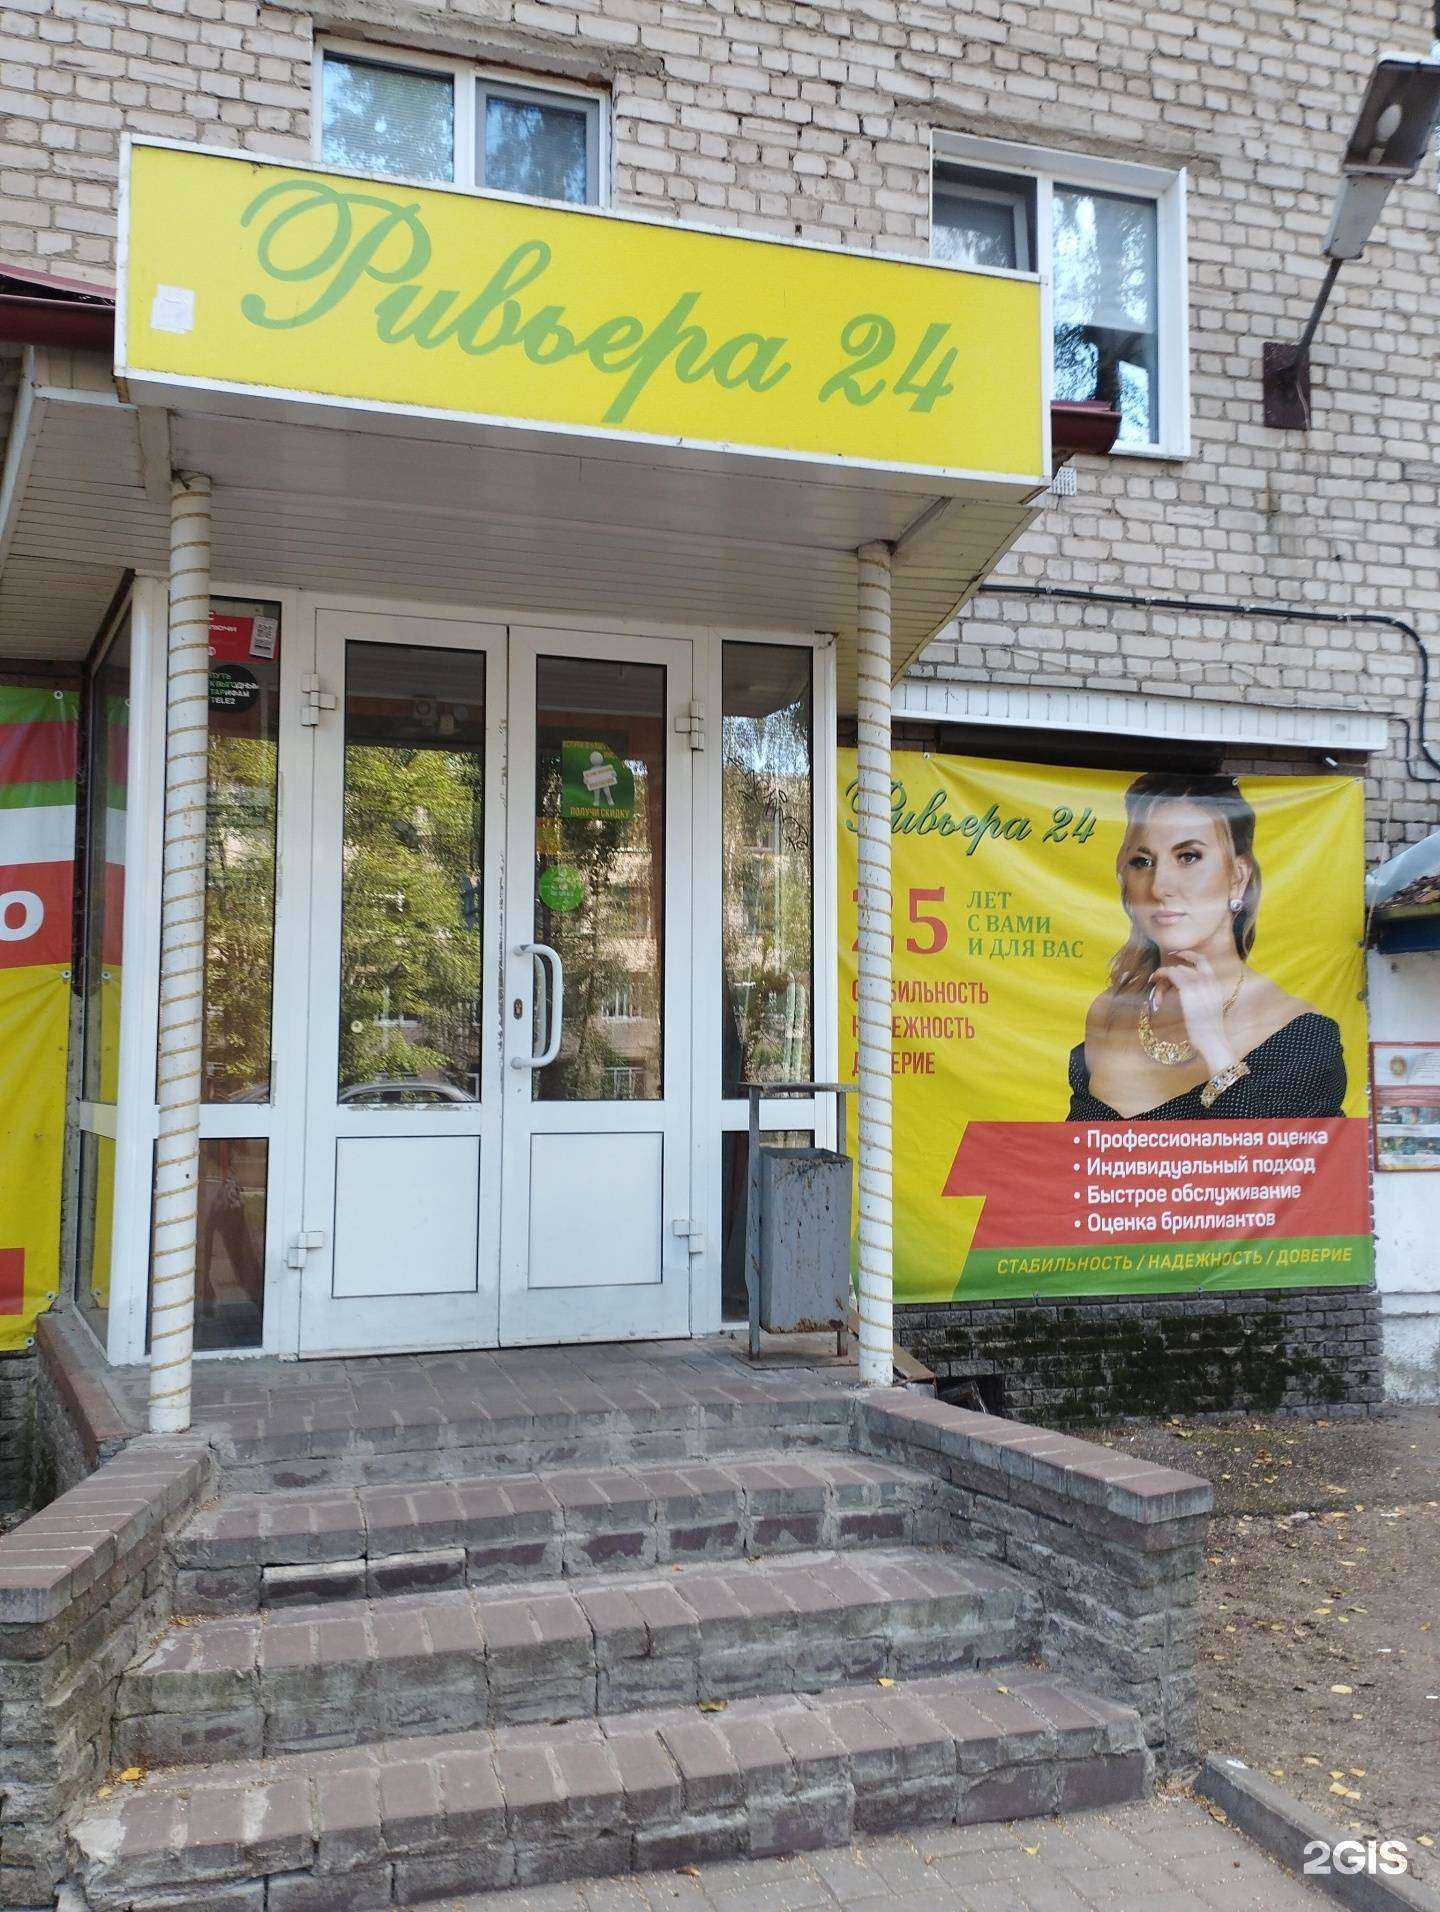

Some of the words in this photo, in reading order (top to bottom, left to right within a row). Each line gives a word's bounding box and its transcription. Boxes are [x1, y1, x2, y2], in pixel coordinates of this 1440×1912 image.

[240, 180, 791, 423] Ривьера
[818, 312, 960, 413] 24
[1042, 805, 1098, 844] 24
[966, 890, 1013, 910] ЛЕТ
[967, 913, 980, 932] С
[987, 915, 1051, 935] ВАМИ
[968, 938, 983, 957] И
[988, 938, 1035, 960] ДЛЯ
[1042, 940, 1084, 960] ВАС
[1087, 1129, 1264, 1153] Профессиональная
[1267, 1130, 1329, 1148] оценка
[1087, 1155, 1249, 1180] Индивидуальный
[1252, 1156, 1316, 1174] подход
[1087, 1185, 1167, 1207] Быстрое
[1171, 1183, 1302, 1206] обслуживание
[1087, 1213, 1157, 1234] Оценка
[1161, 1211, 1276, 1234] бриллиантов
[997, 1254, 1133, 1275] СТАБИЛЬНОСТЬ
[1148, 1251, 1263, 1271] НАДЕЖНОСТЬ
[1276, 1247, 1353, 1265] ДОВЕРИЕ
